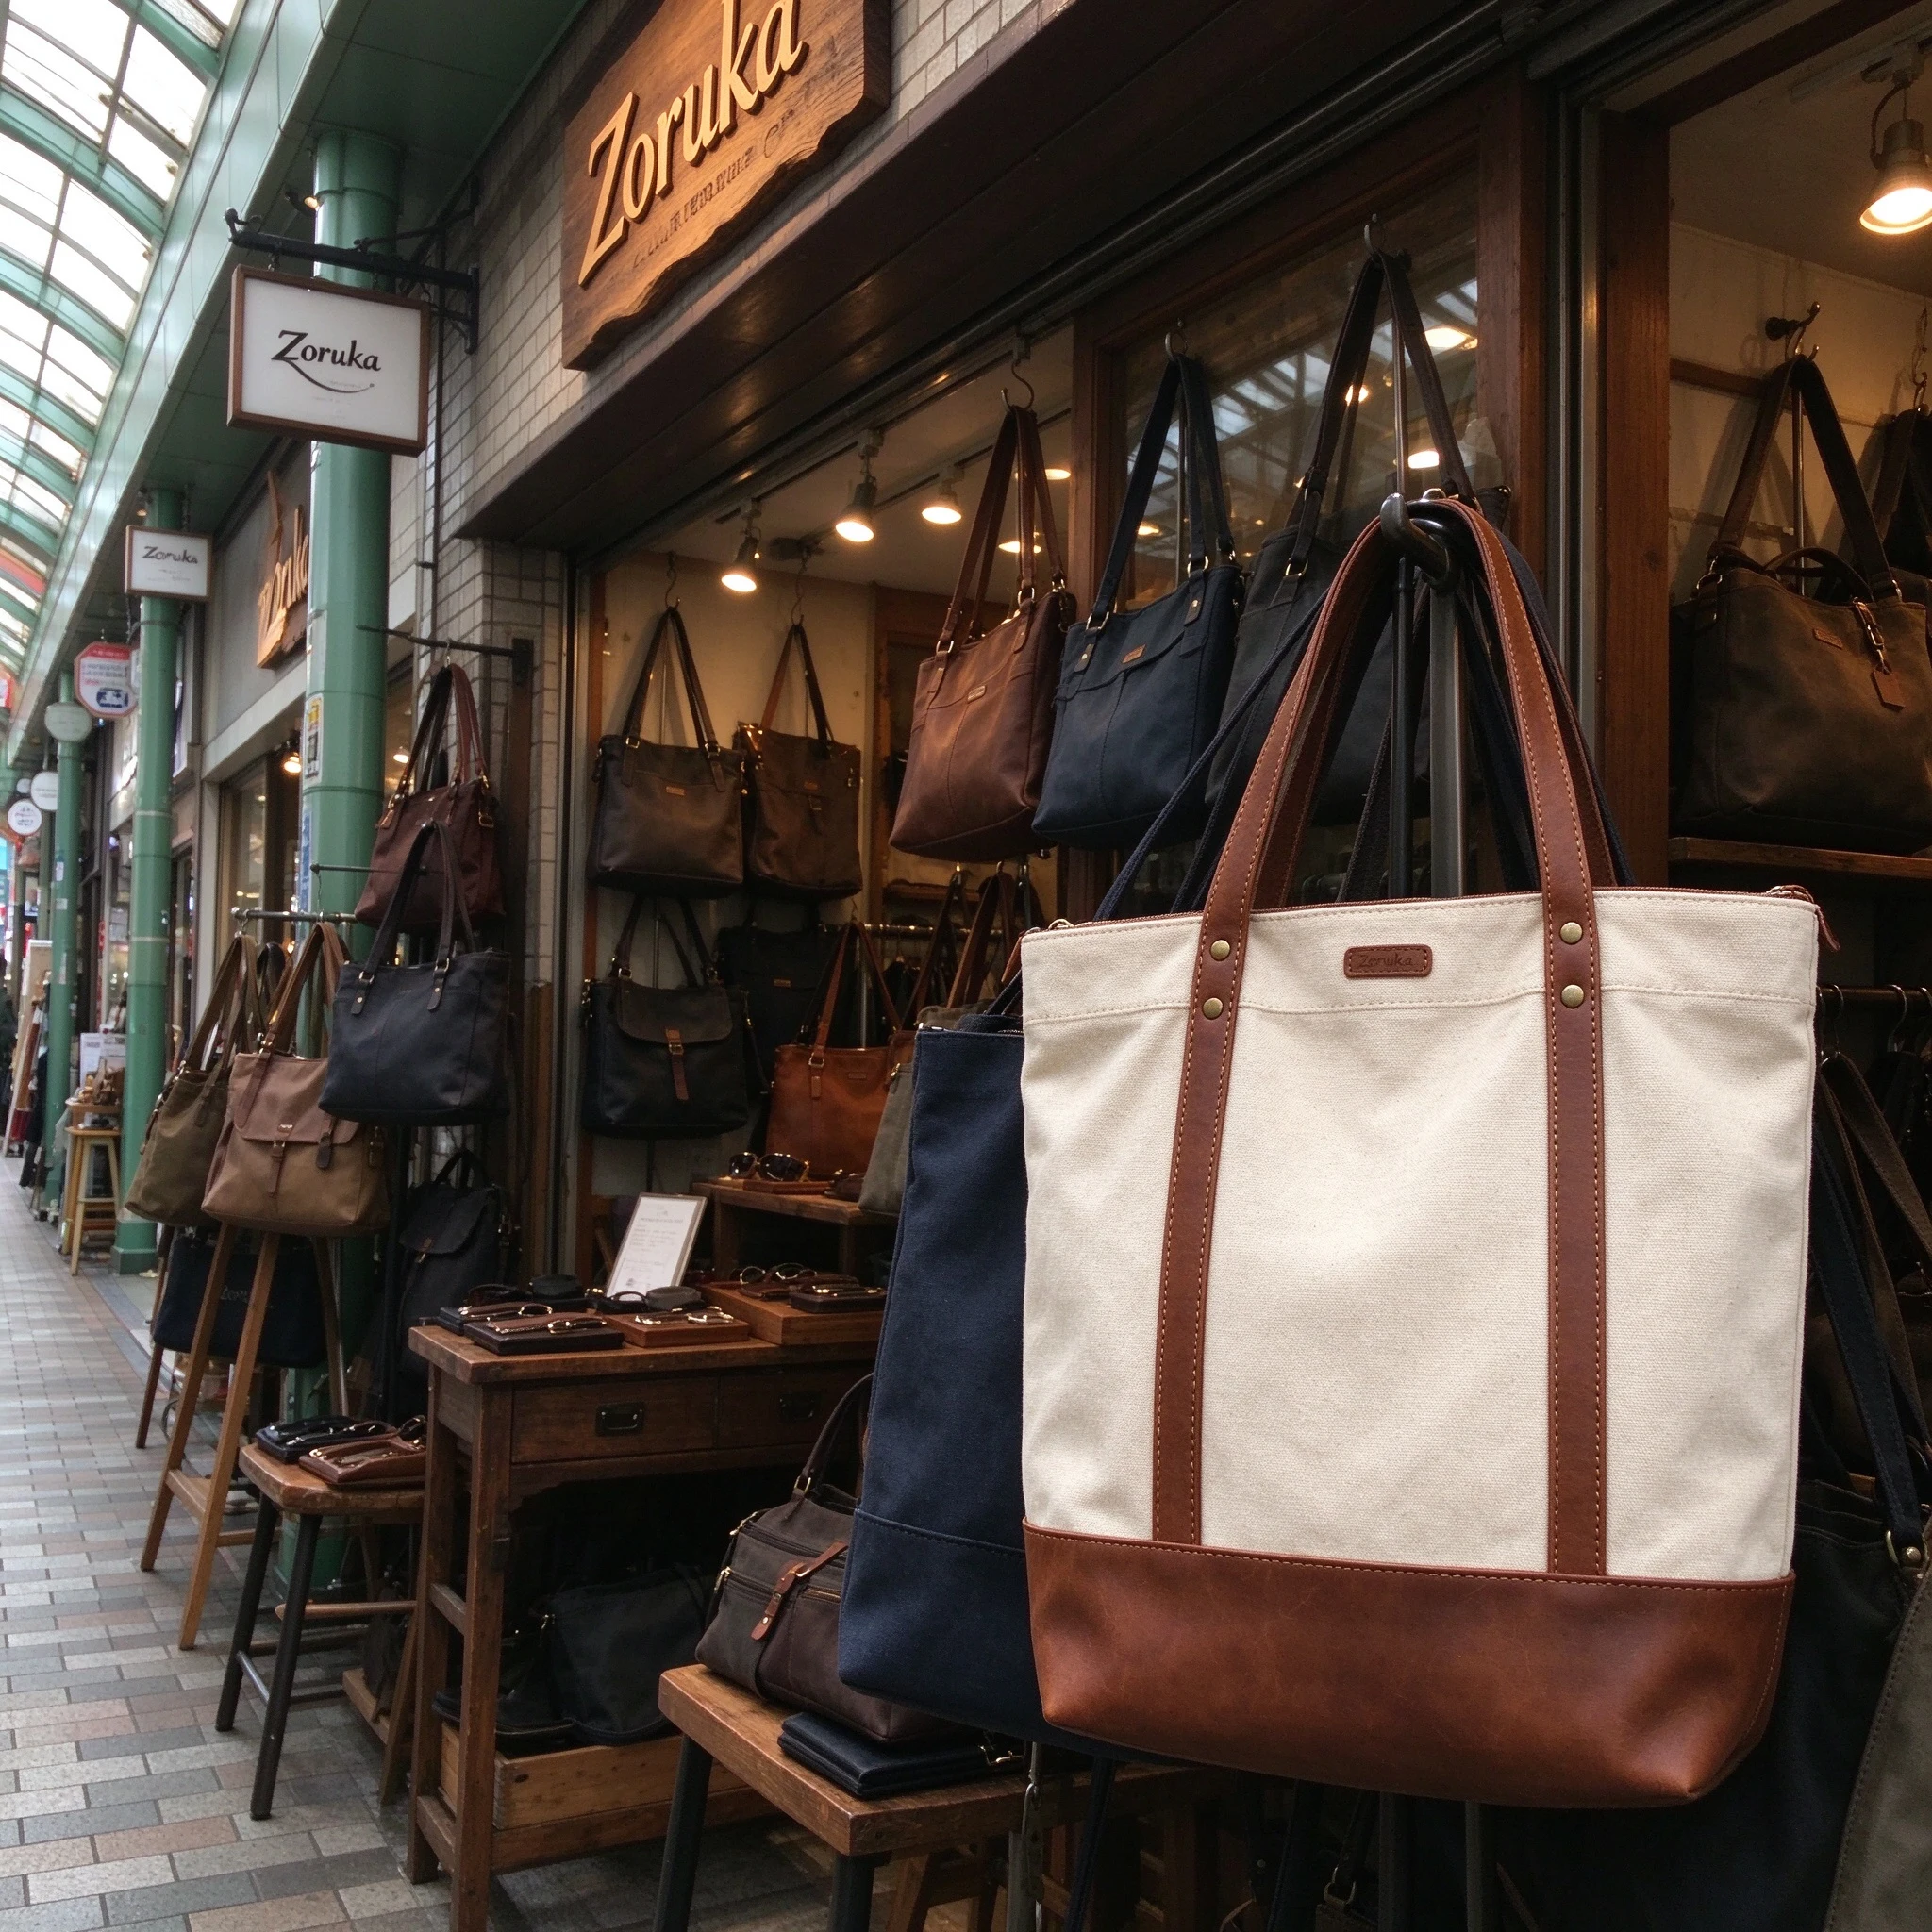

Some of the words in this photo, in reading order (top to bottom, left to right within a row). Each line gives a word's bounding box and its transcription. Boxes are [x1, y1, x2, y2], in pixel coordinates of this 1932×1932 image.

[578, 0, 808, 289] Zoruka
[271, 329, 381, 373] Zoruka
[142, 546, 198, 564] Zoruka
